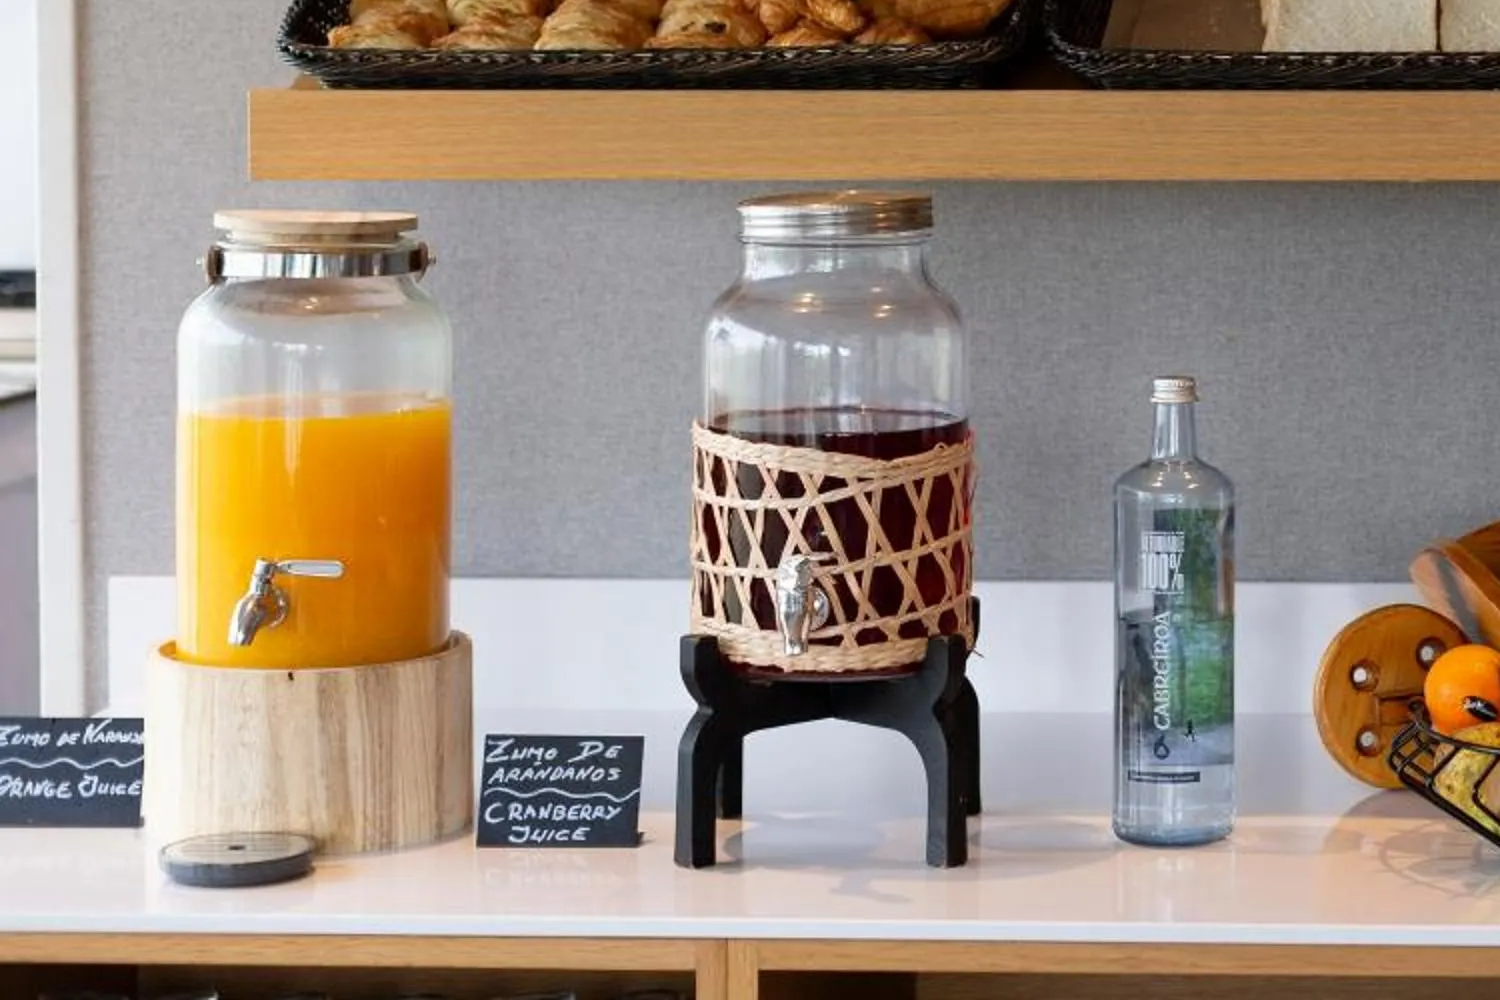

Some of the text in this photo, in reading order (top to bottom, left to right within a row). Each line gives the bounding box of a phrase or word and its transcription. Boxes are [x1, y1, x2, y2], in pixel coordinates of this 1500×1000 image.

[485, 738, 559, 763] ZUMO
[78, 773, 142, 798] JUICE
[484, 801, 622, 823] CRANBERRY
[508, 825, 591, 843] JUICE
